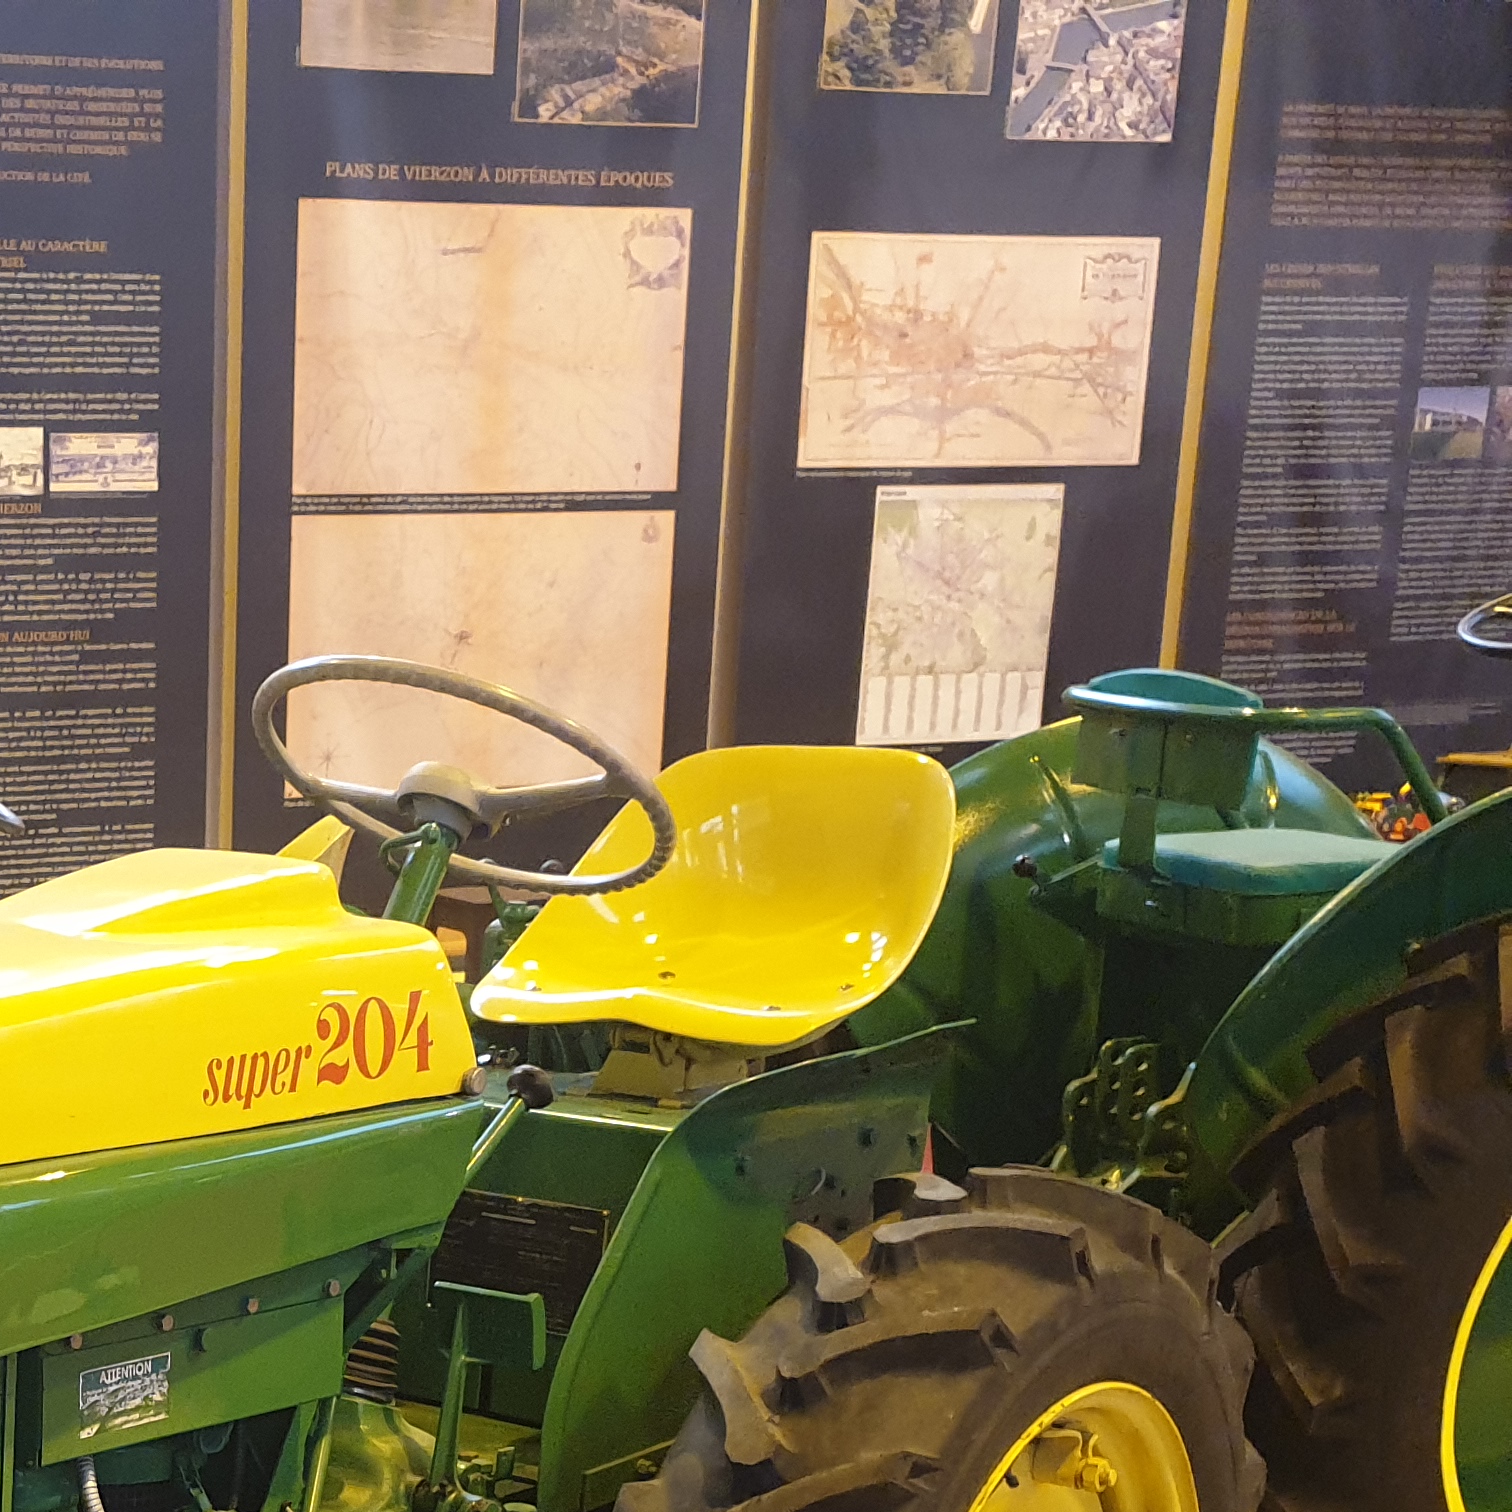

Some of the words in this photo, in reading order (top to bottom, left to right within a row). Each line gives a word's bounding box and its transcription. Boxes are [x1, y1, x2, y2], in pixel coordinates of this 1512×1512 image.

[326, 161, 374, 180] PLANS
[378, 164, 399, 180] DE
[403, 165, 475, 182] VIERZON
[478, 163, 490, 182] À
[495, 165, 596, 186] DIFFÉRENTES
[600, 166, 674, 188] ÉPOQUES
[19, 240, 36, 251] AU
[38, 239, 108, 253] CARACTÈRE
[202, 1044, 312, 1110] super
[316, 990, 434, 1087] 204
[99, 1360, 152, 1384] ATTENTION
